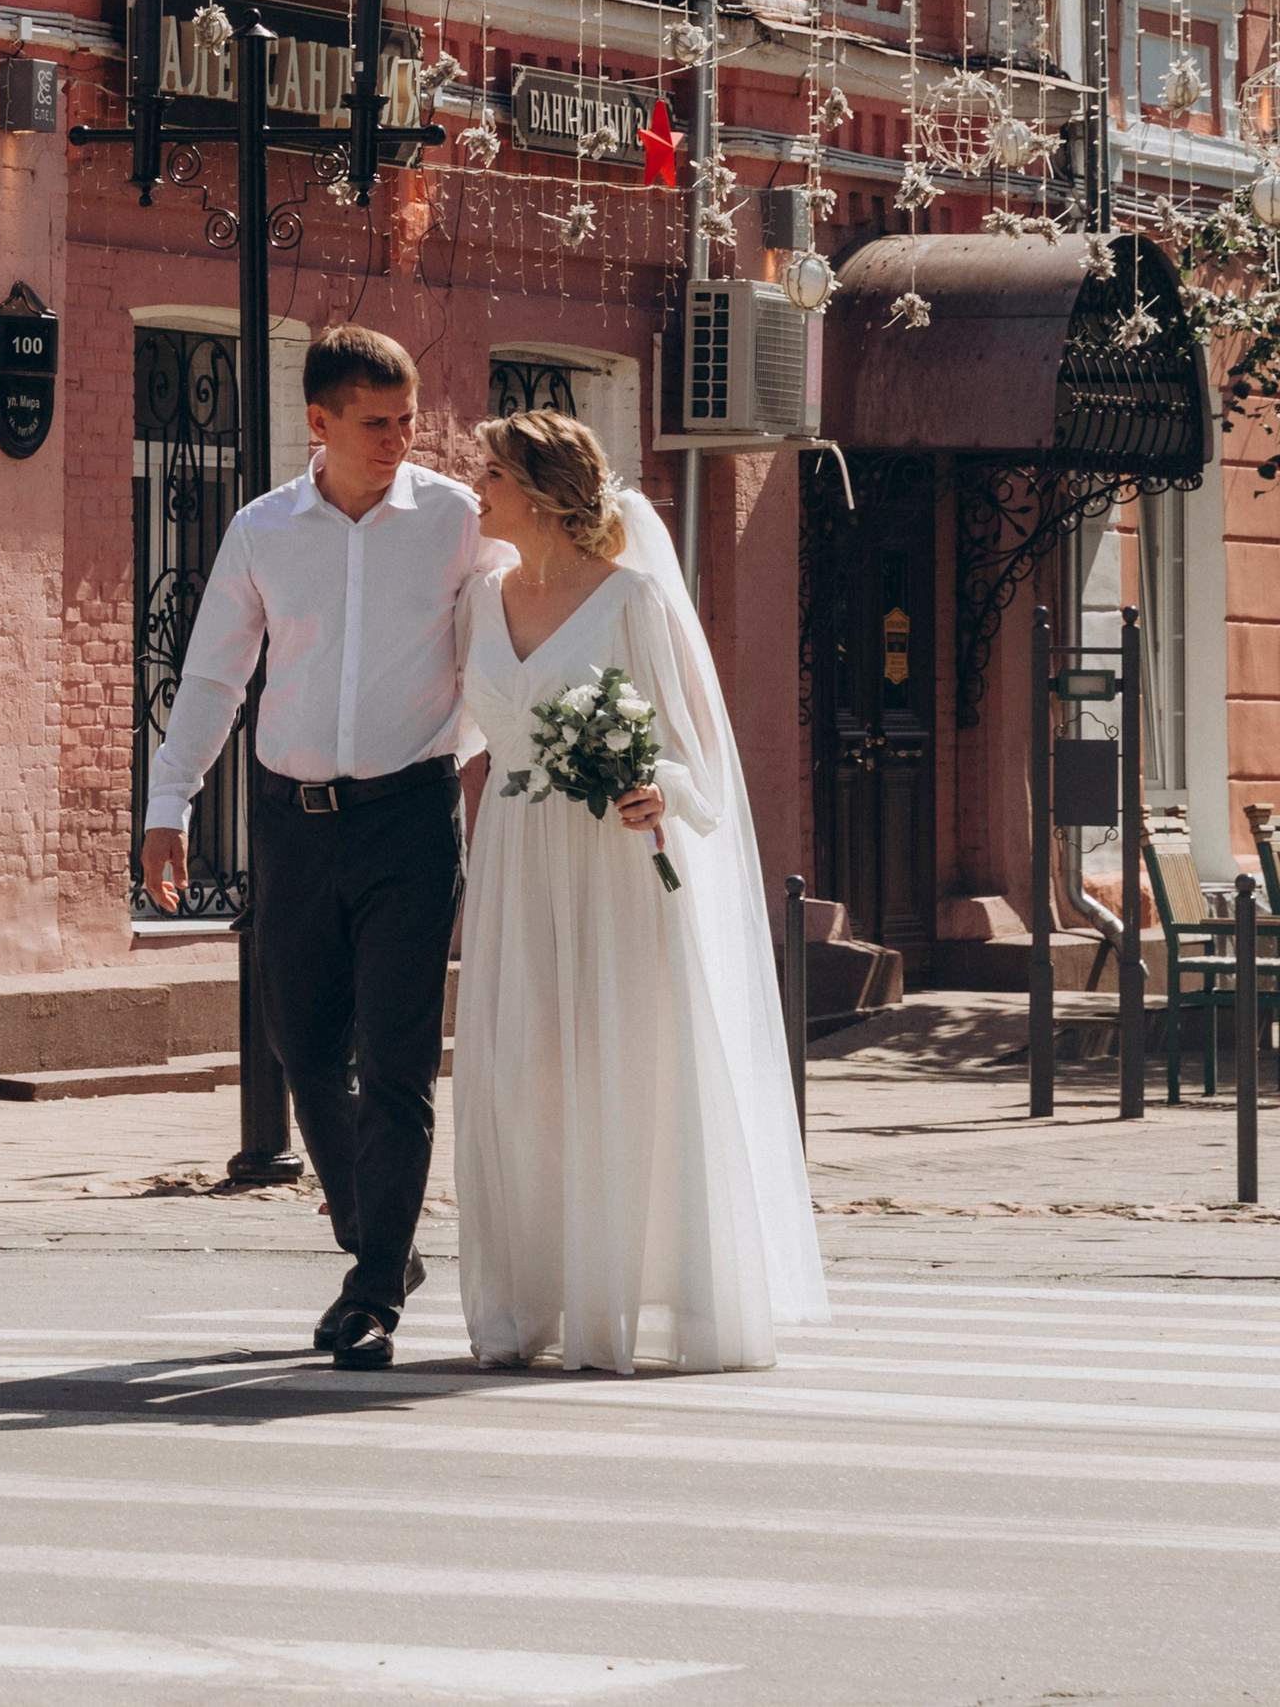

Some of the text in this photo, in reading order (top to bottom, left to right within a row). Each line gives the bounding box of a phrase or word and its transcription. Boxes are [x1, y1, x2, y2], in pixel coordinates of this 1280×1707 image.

[159, 15, 421, 129] АЛЕСАНДИЯ
[529, 89, 632, 144] БАНКЕТНЫЙ
[12, 336, 43, 355] 100
[7, 395, 40, 411] ул. Мира
